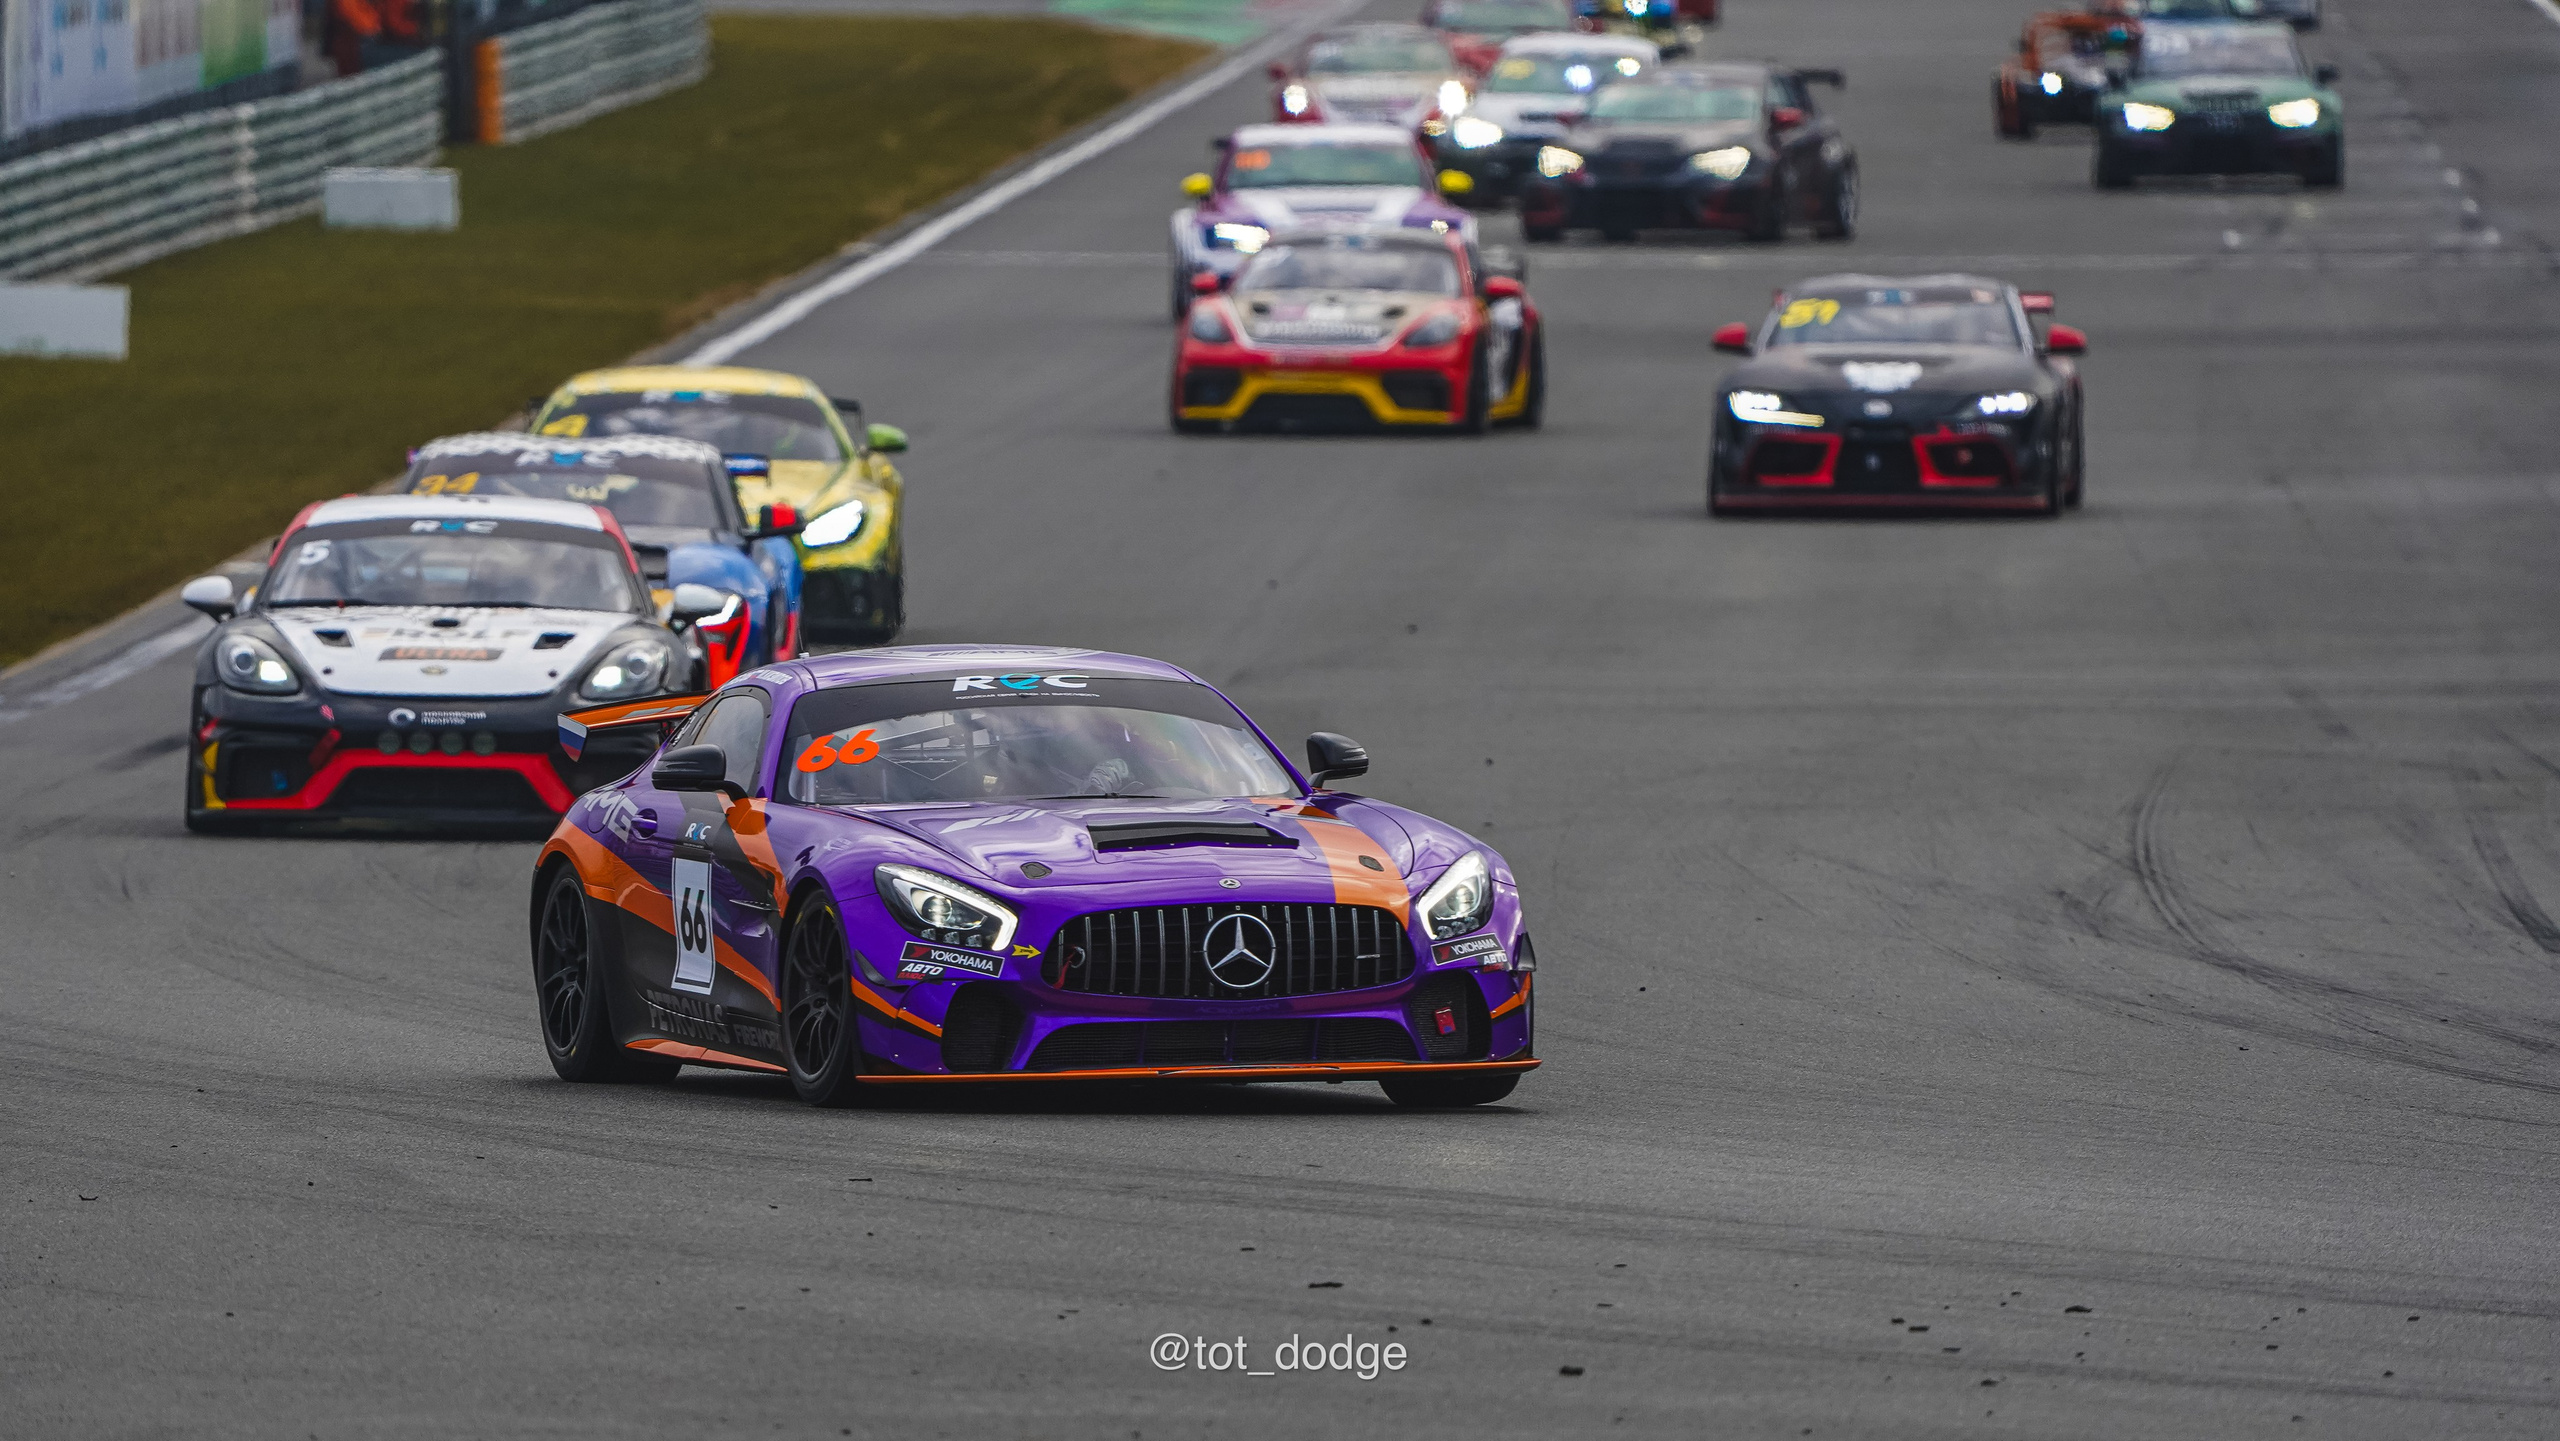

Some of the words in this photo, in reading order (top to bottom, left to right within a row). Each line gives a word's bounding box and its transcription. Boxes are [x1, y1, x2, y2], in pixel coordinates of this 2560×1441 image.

[298, 539, 331, 565] 5
[796, 728, 880, 773] 66
[680, 887, 707, 954] 66
[929, 949, 994, 971] YOKOHAMA
[1451, 938, 1498, 955] YOKOHAMA
[646, 989, 731, 1044] PETRONAS
